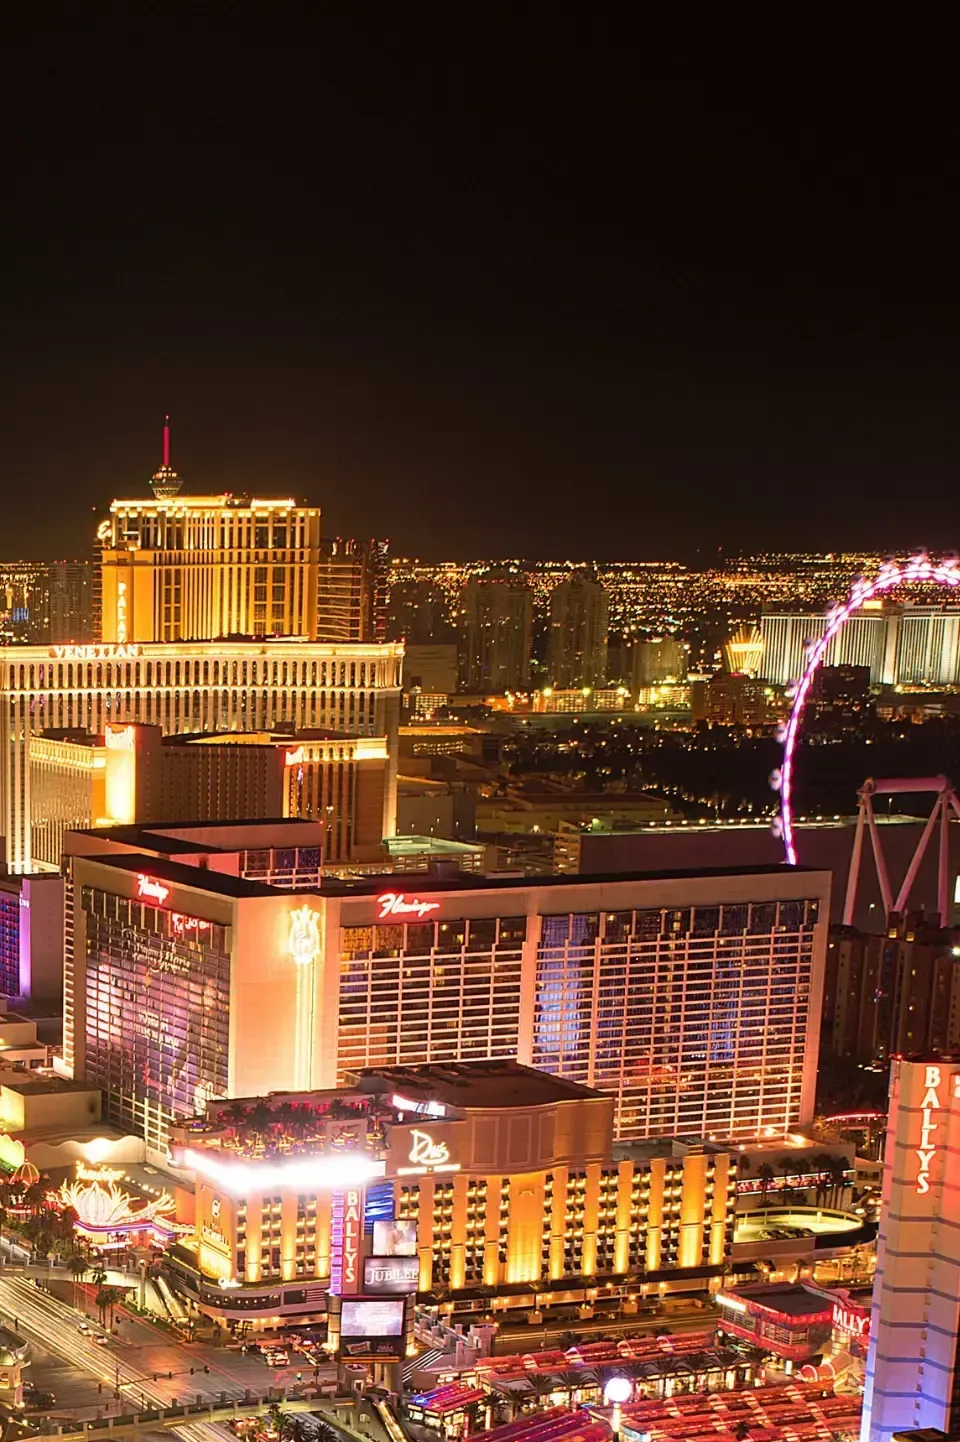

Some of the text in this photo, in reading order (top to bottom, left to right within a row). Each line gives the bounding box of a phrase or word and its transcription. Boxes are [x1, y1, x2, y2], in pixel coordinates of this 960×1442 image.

[52, 644, 140, 659] VENETIAN
[377, 893, 440, 918] Flamingo
[344, 1191, 359, 1283] BALLYS
[364, 1267, 419, 1285] JUBILEE
